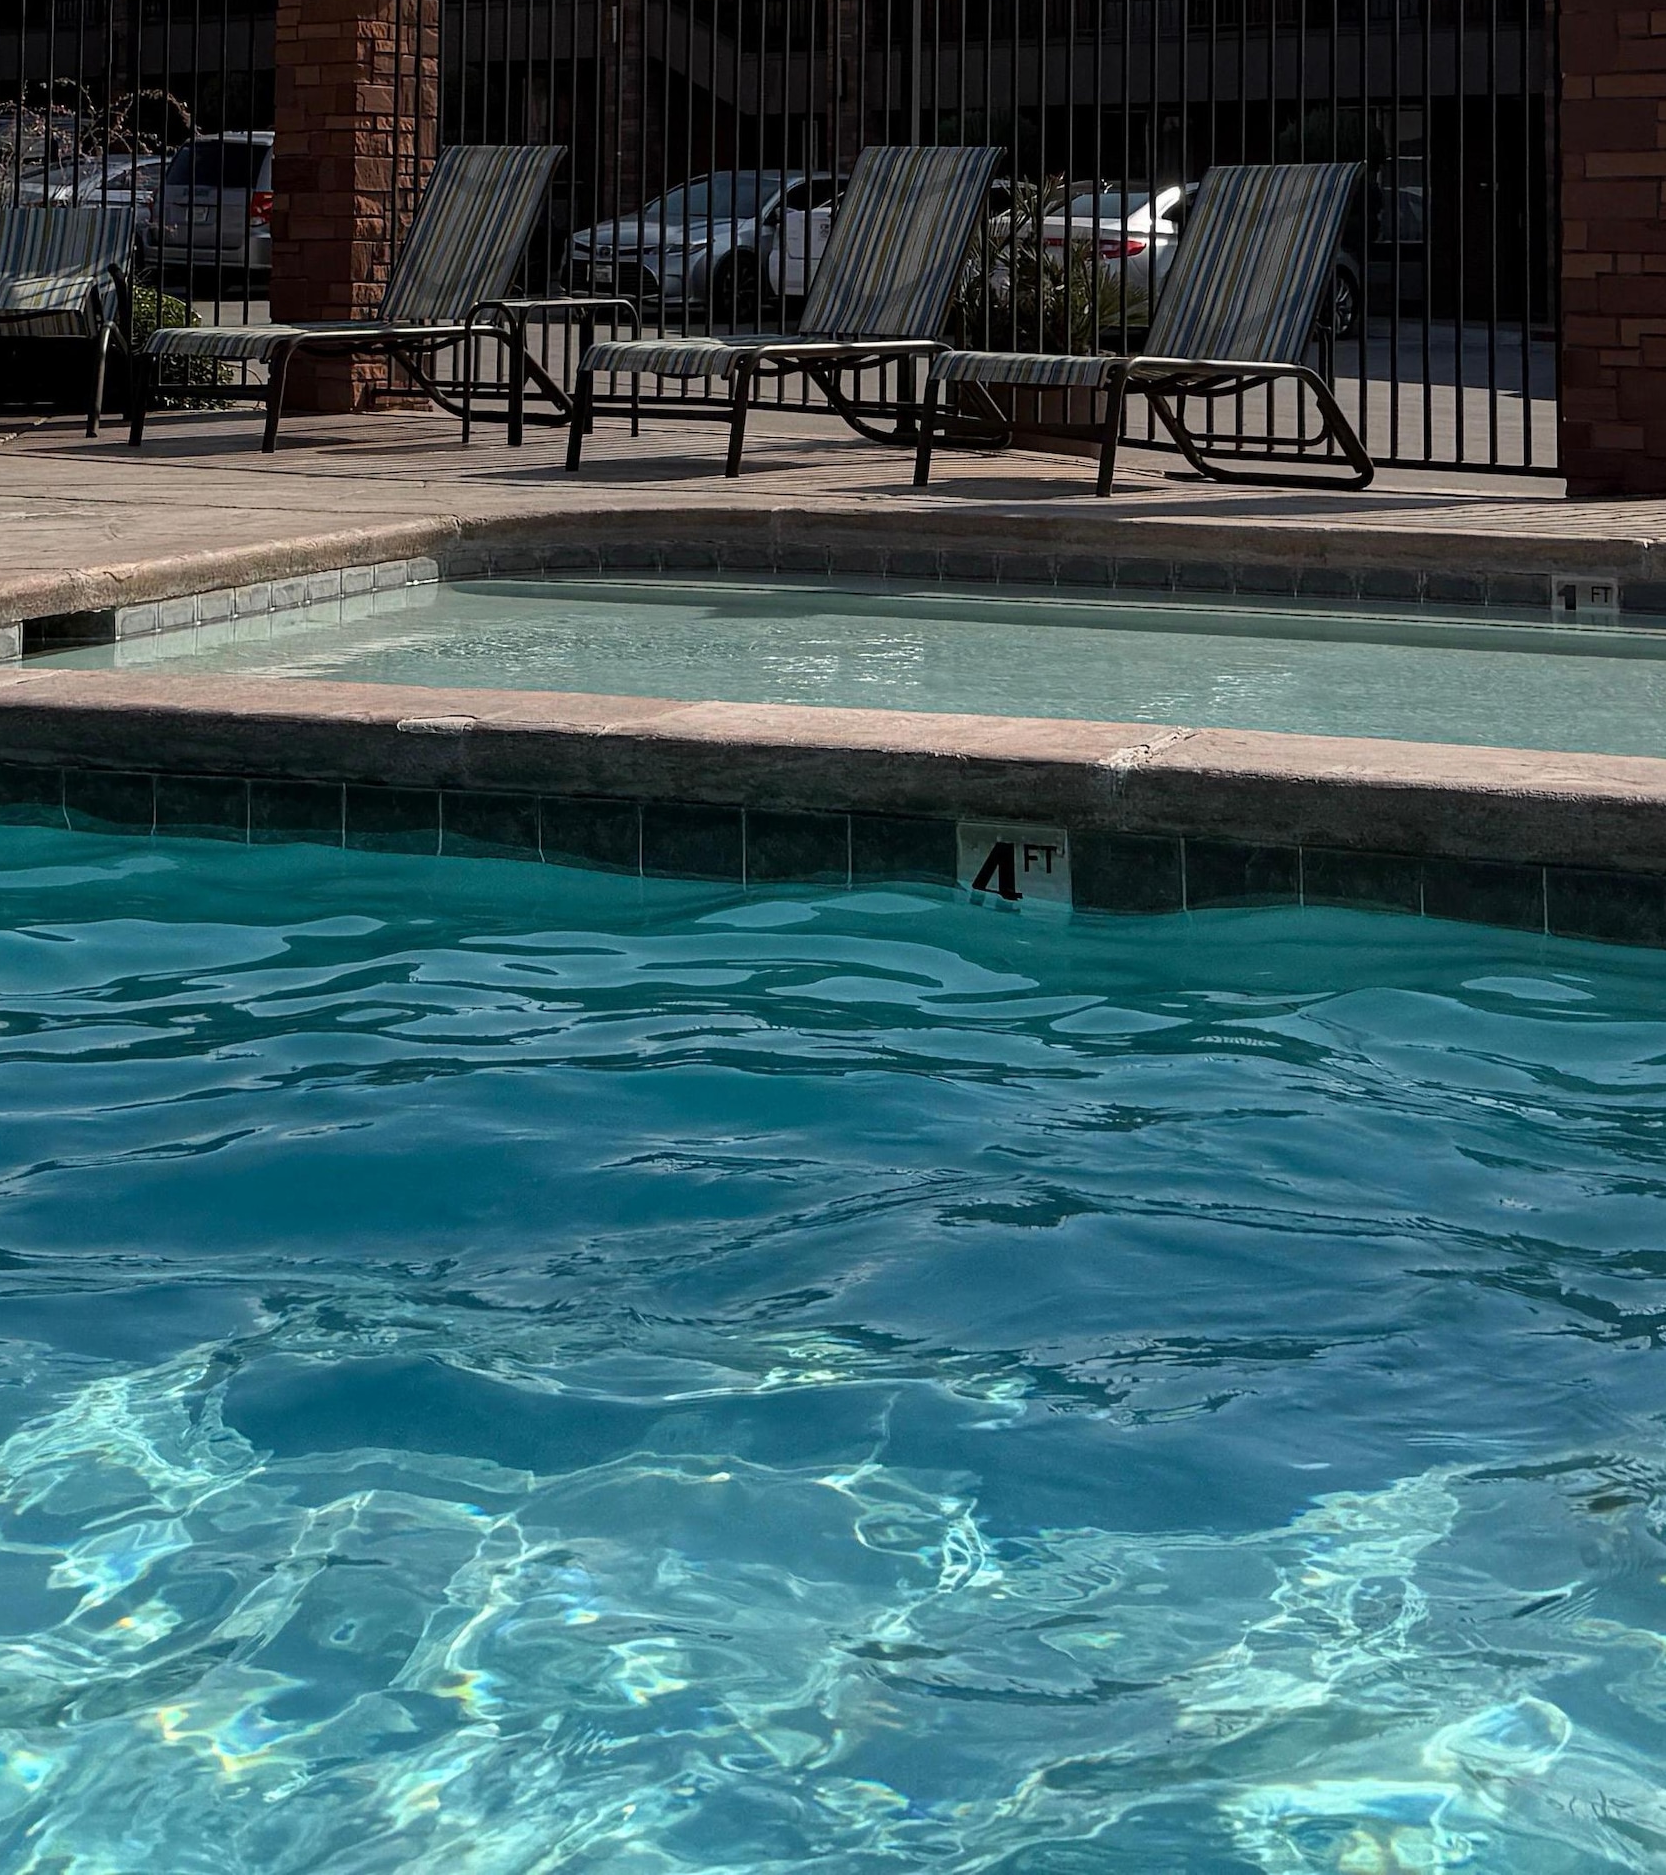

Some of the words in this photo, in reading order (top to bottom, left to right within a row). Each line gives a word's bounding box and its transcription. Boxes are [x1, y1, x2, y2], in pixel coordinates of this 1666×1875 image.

[1558, 585, 1577, 611] 1
[1591, 586, 1612, 603] FT
[972, 842, 1024, 901] 4
[1024, 844, 1057, 874] FT
